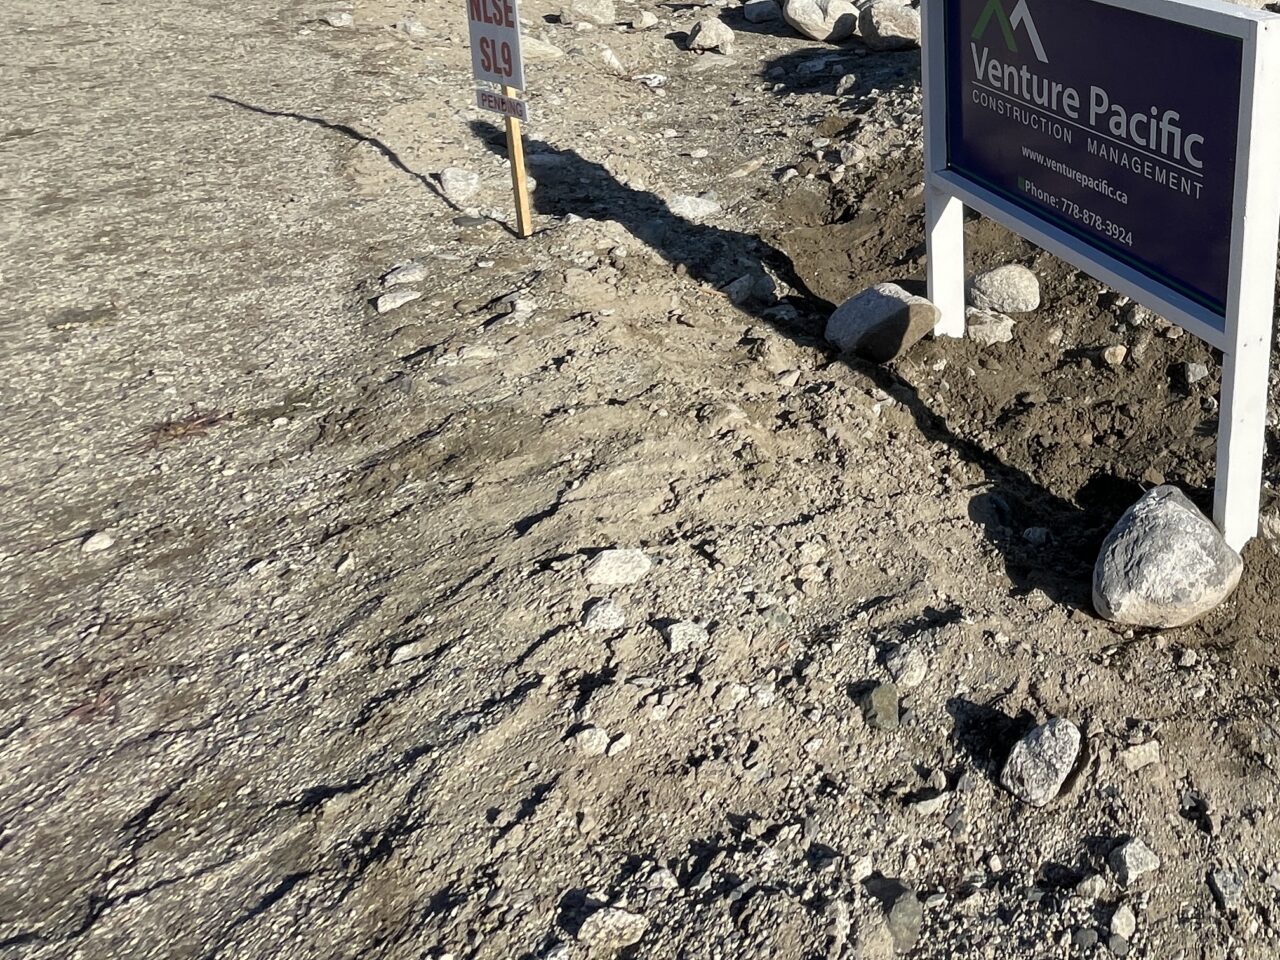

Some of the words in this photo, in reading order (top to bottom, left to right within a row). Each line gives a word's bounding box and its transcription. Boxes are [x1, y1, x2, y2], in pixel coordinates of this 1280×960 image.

[479, 36, 513, 78] SL9
[481, 92, 523, 117] PENDING
[970, 42, 1080, 119] Venture
[1089, 85, 1205, 169] Pacific
[972, 89, 1072, 144] CONSTRUCTION
[1087, 137, 1204, 200] MANAGEMENT
[1021, 145, 1128, 205] www.venturepacific.ca
[1025, 179, 1059, 209] Phone:
[1061, 197, 1133, 247] 778-878-3924
